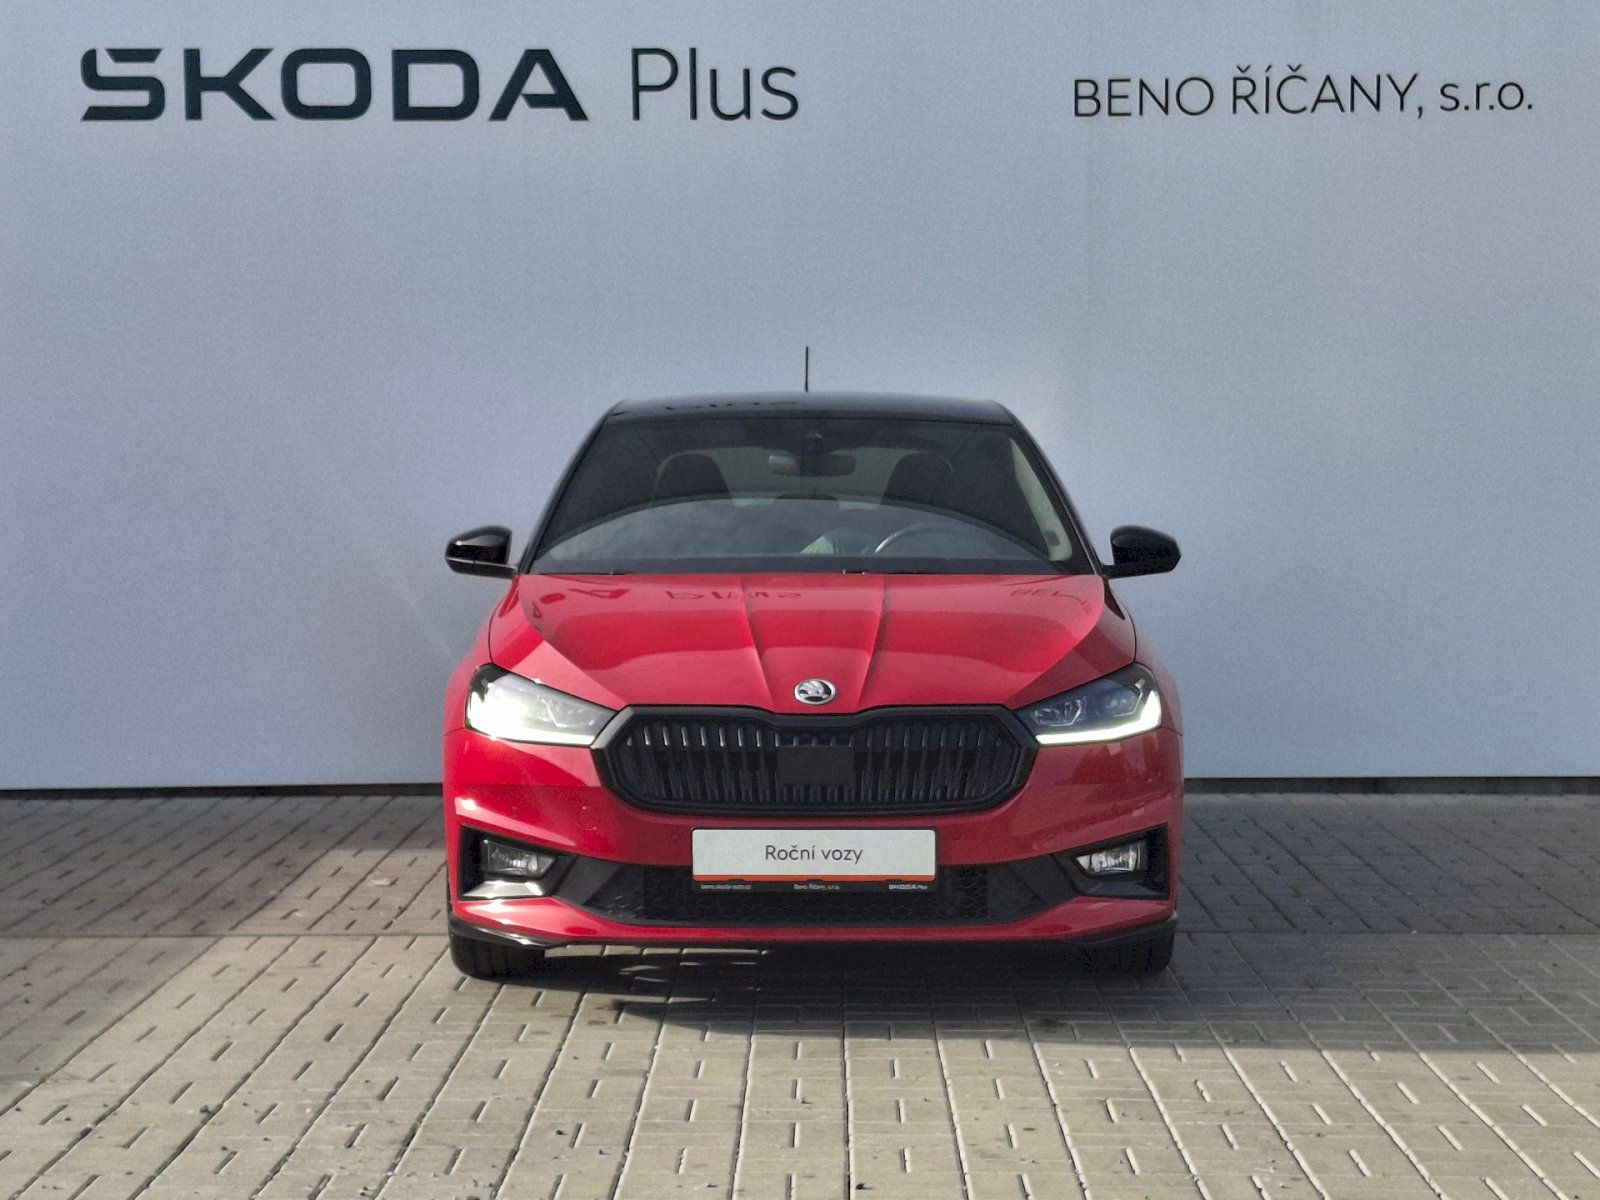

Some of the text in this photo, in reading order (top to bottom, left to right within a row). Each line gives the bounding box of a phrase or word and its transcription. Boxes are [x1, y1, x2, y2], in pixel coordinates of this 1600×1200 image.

[631, 47, 800, 122] Plus
[1074, 64, 1532, 119] BENO ŘÍČANY, s.r.o.
[766, 844, 864, 865] Roční vozy
